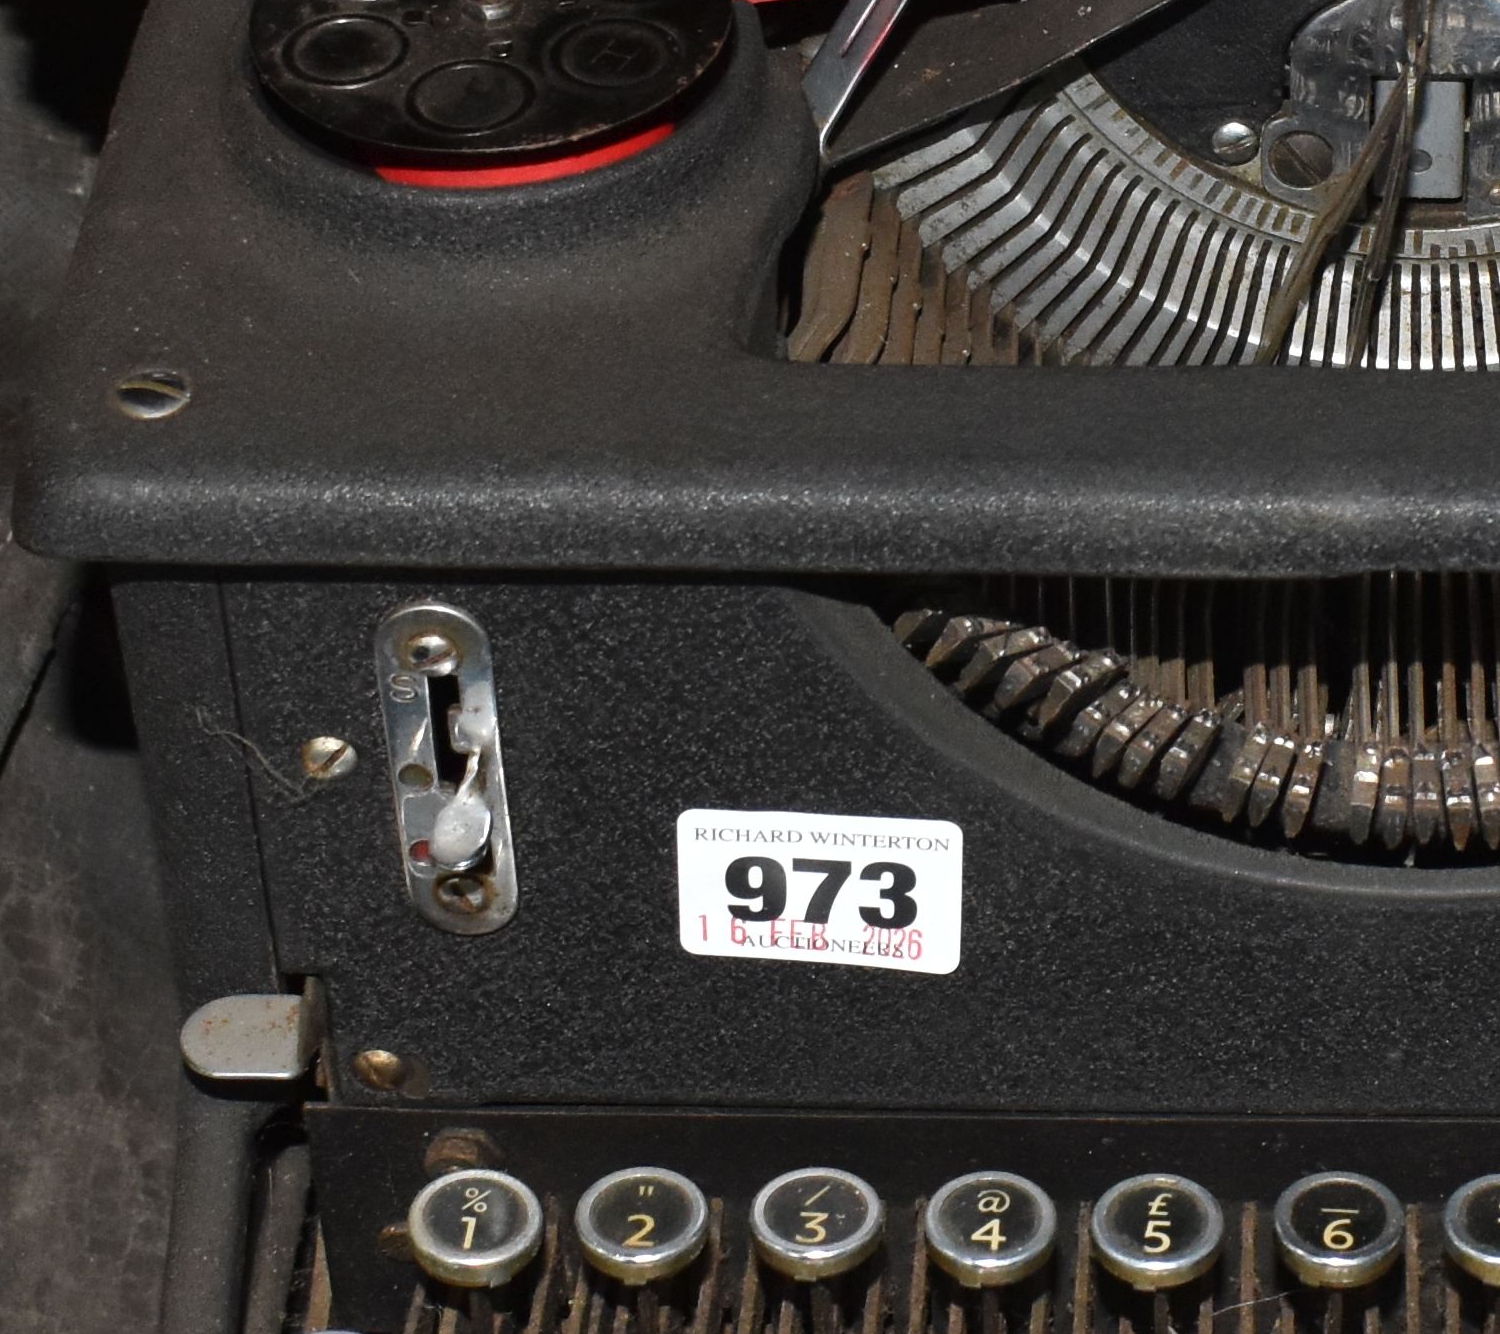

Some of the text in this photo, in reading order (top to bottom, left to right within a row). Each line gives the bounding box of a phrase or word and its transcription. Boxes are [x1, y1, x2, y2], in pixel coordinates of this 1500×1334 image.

[694, 827, 950, 851] RICHARD WINTERTON
[725, 856, 918, 929] 973
[742, 935, 905, 959] AUCTIONEERS
[463, 1187, 491, 1212] %
[977, 1189, 1010, 1214] @
[1149, 1192, 1171, 1216] £
[460, 1216, 476, 1249] 1
[622, 1214, 655, 1247] 2
[795, 1212, 829, 1244] 3
[970, 1219, 1006, 1250] 4
[1144, 1221, 1172, 1253] 5
[1324, 1219, 1354, 1250] 6
